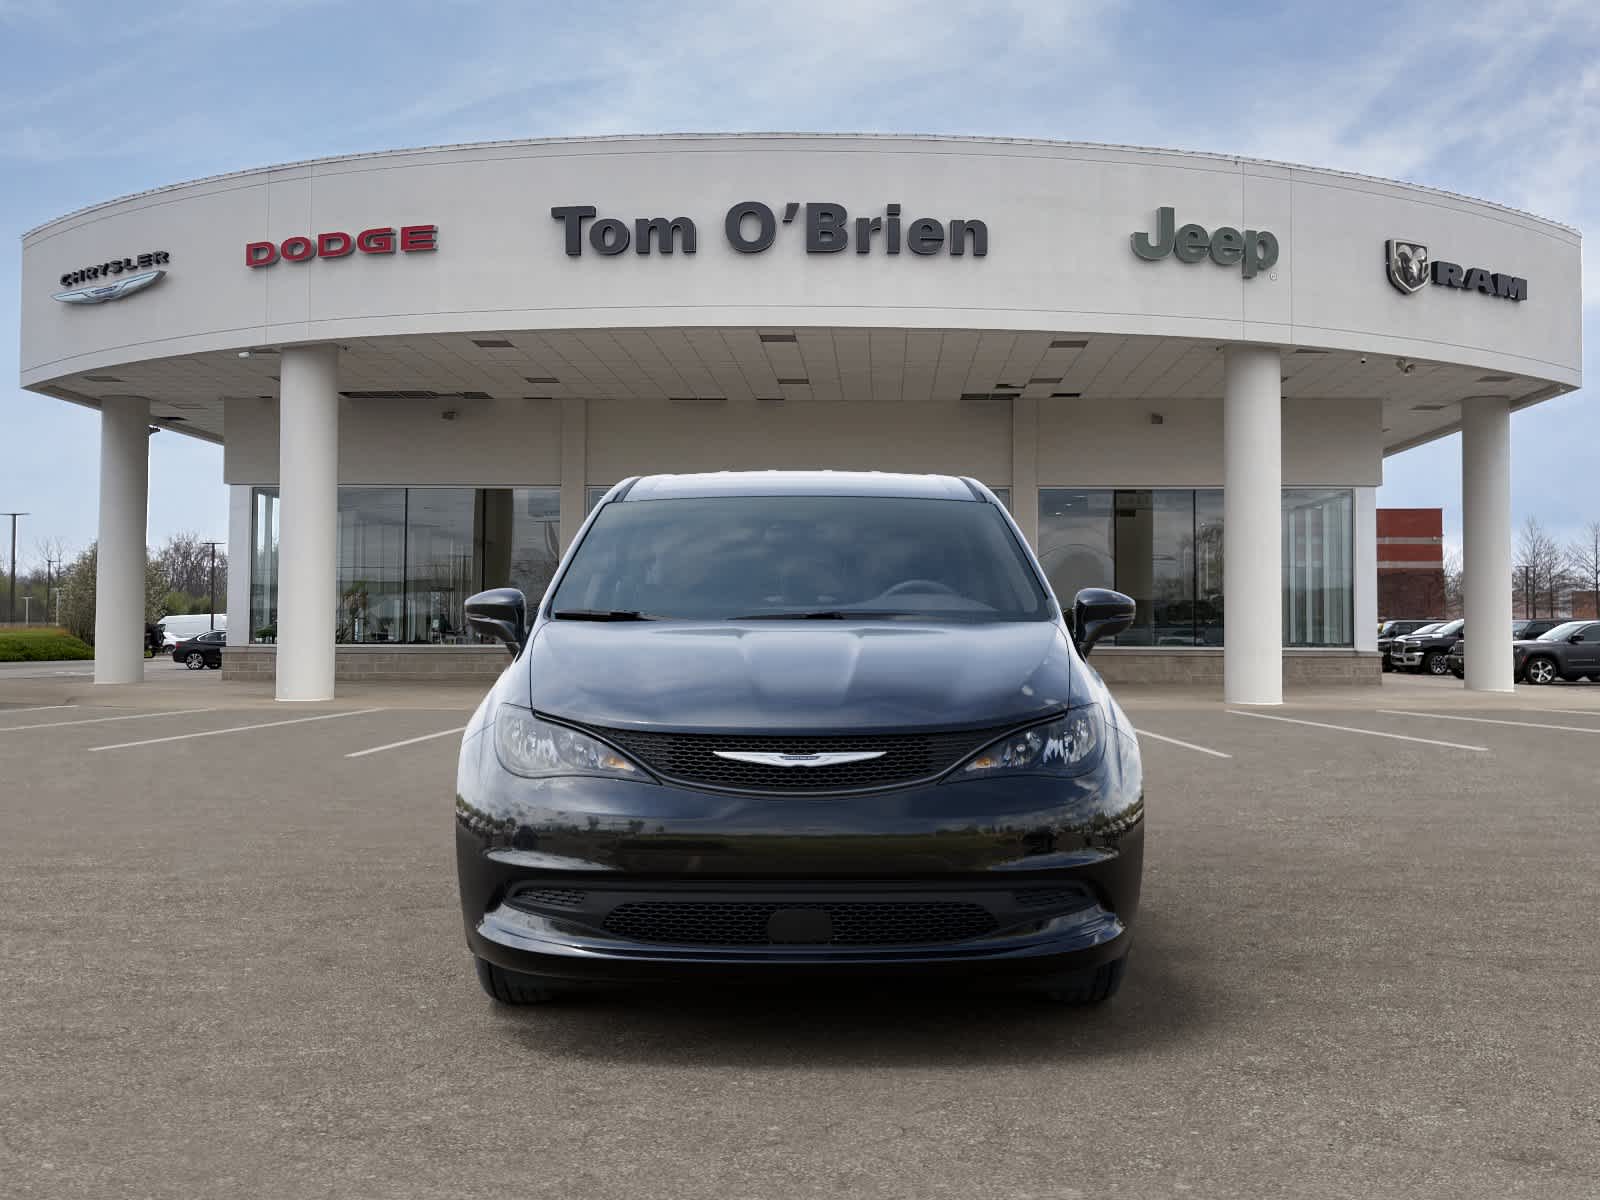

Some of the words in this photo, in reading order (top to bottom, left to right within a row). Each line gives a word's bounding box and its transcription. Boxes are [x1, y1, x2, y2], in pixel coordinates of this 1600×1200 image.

[245, 224, 437, 269] DODGE
[551, 204, 697, 257] Tom
[725, 201, 989, 257] O'Brien
[1130, 206, 1280, 279] Jeep
[60, 250, 170, 287] CHRYSLER
[1431, 260, 1528, 302] RAM
